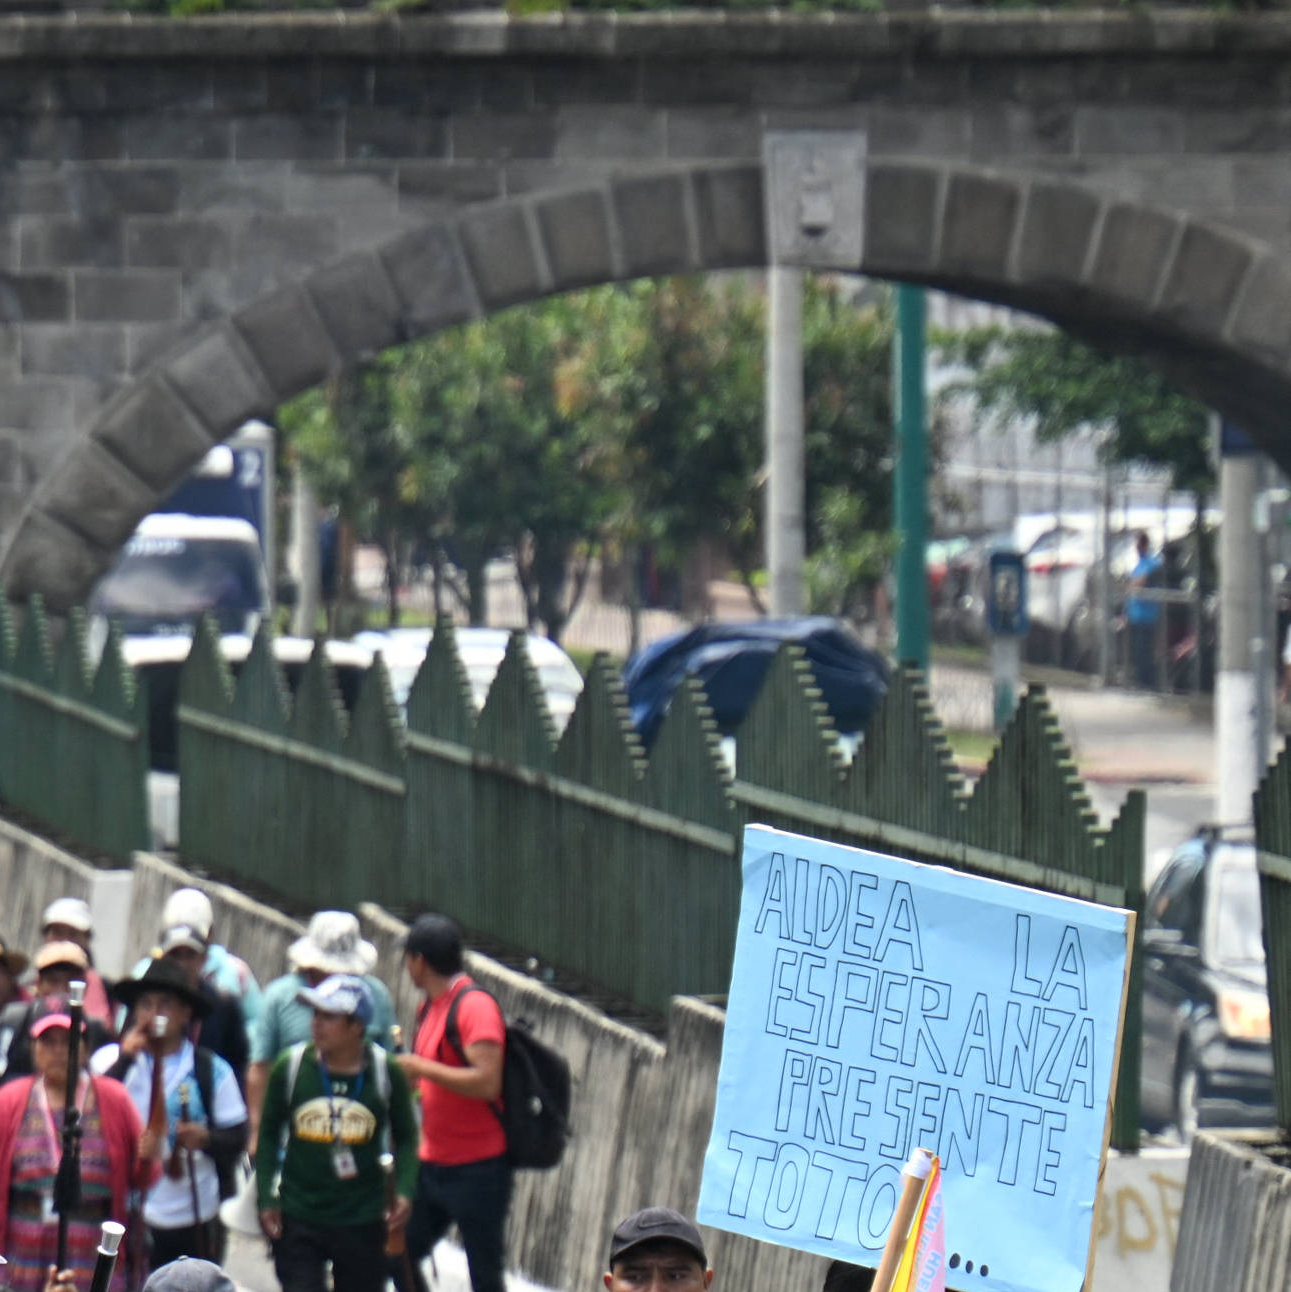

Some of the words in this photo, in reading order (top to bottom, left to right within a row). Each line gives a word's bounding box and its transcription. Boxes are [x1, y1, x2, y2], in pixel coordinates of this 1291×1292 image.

[755, 852, 923, 971] ALDEA
[1010, 914, 1088, 1010] LA
[765, 947, 1095, 1108] ESPERANZA
[727, 1130, 898, 1250] TOTO
[775, 1048, 1067, 1196] PRESENTE
